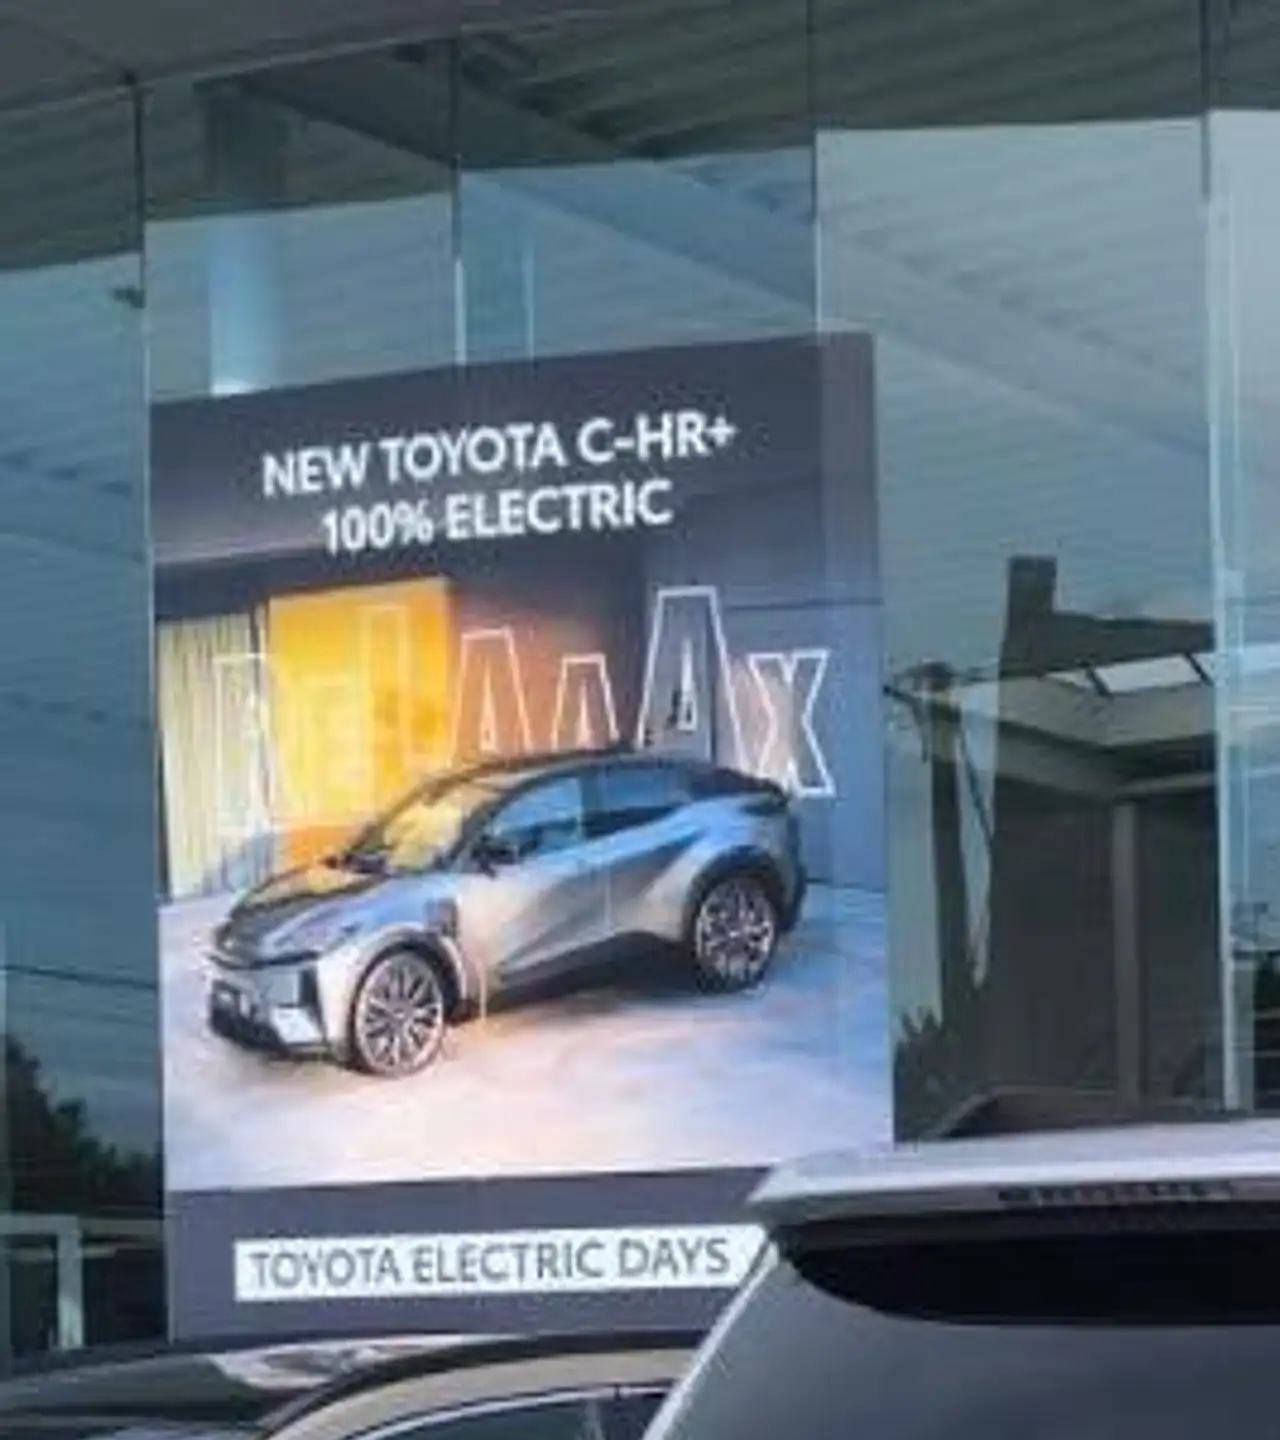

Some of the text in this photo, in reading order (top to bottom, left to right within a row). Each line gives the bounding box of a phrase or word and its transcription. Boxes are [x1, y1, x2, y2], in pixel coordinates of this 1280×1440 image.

[262, 409, 739, 500] NEW TOYOTA C-HR+
[322, 480, 675, 555] 100% ELECTRIC
[249, 1236, 730, 1290] TOYOTA ELECTRIC DAYS
